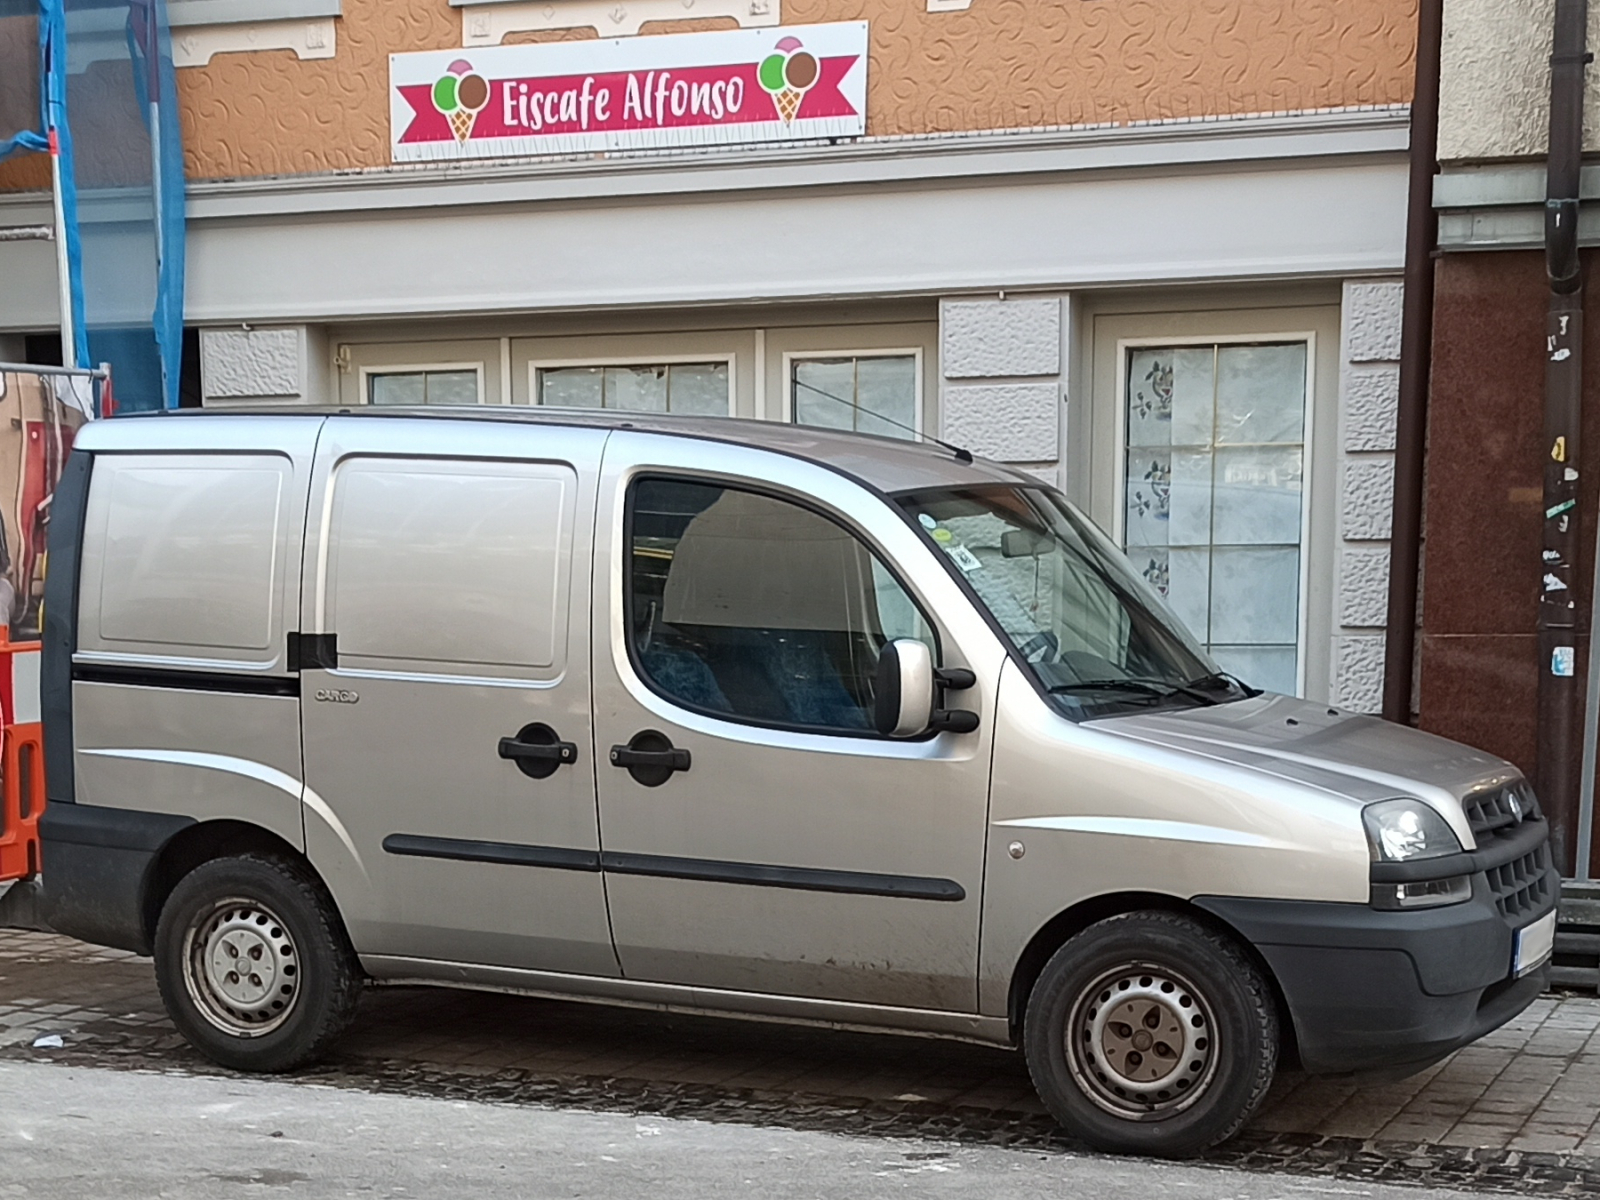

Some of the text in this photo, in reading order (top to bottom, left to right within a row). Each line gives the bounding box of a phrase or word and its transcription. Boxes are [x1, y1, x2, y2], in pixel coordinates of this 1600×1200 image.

[503, 72, 743, 130] Eiscafe Alfonso
[315, 689, 359, 704] CARGO
